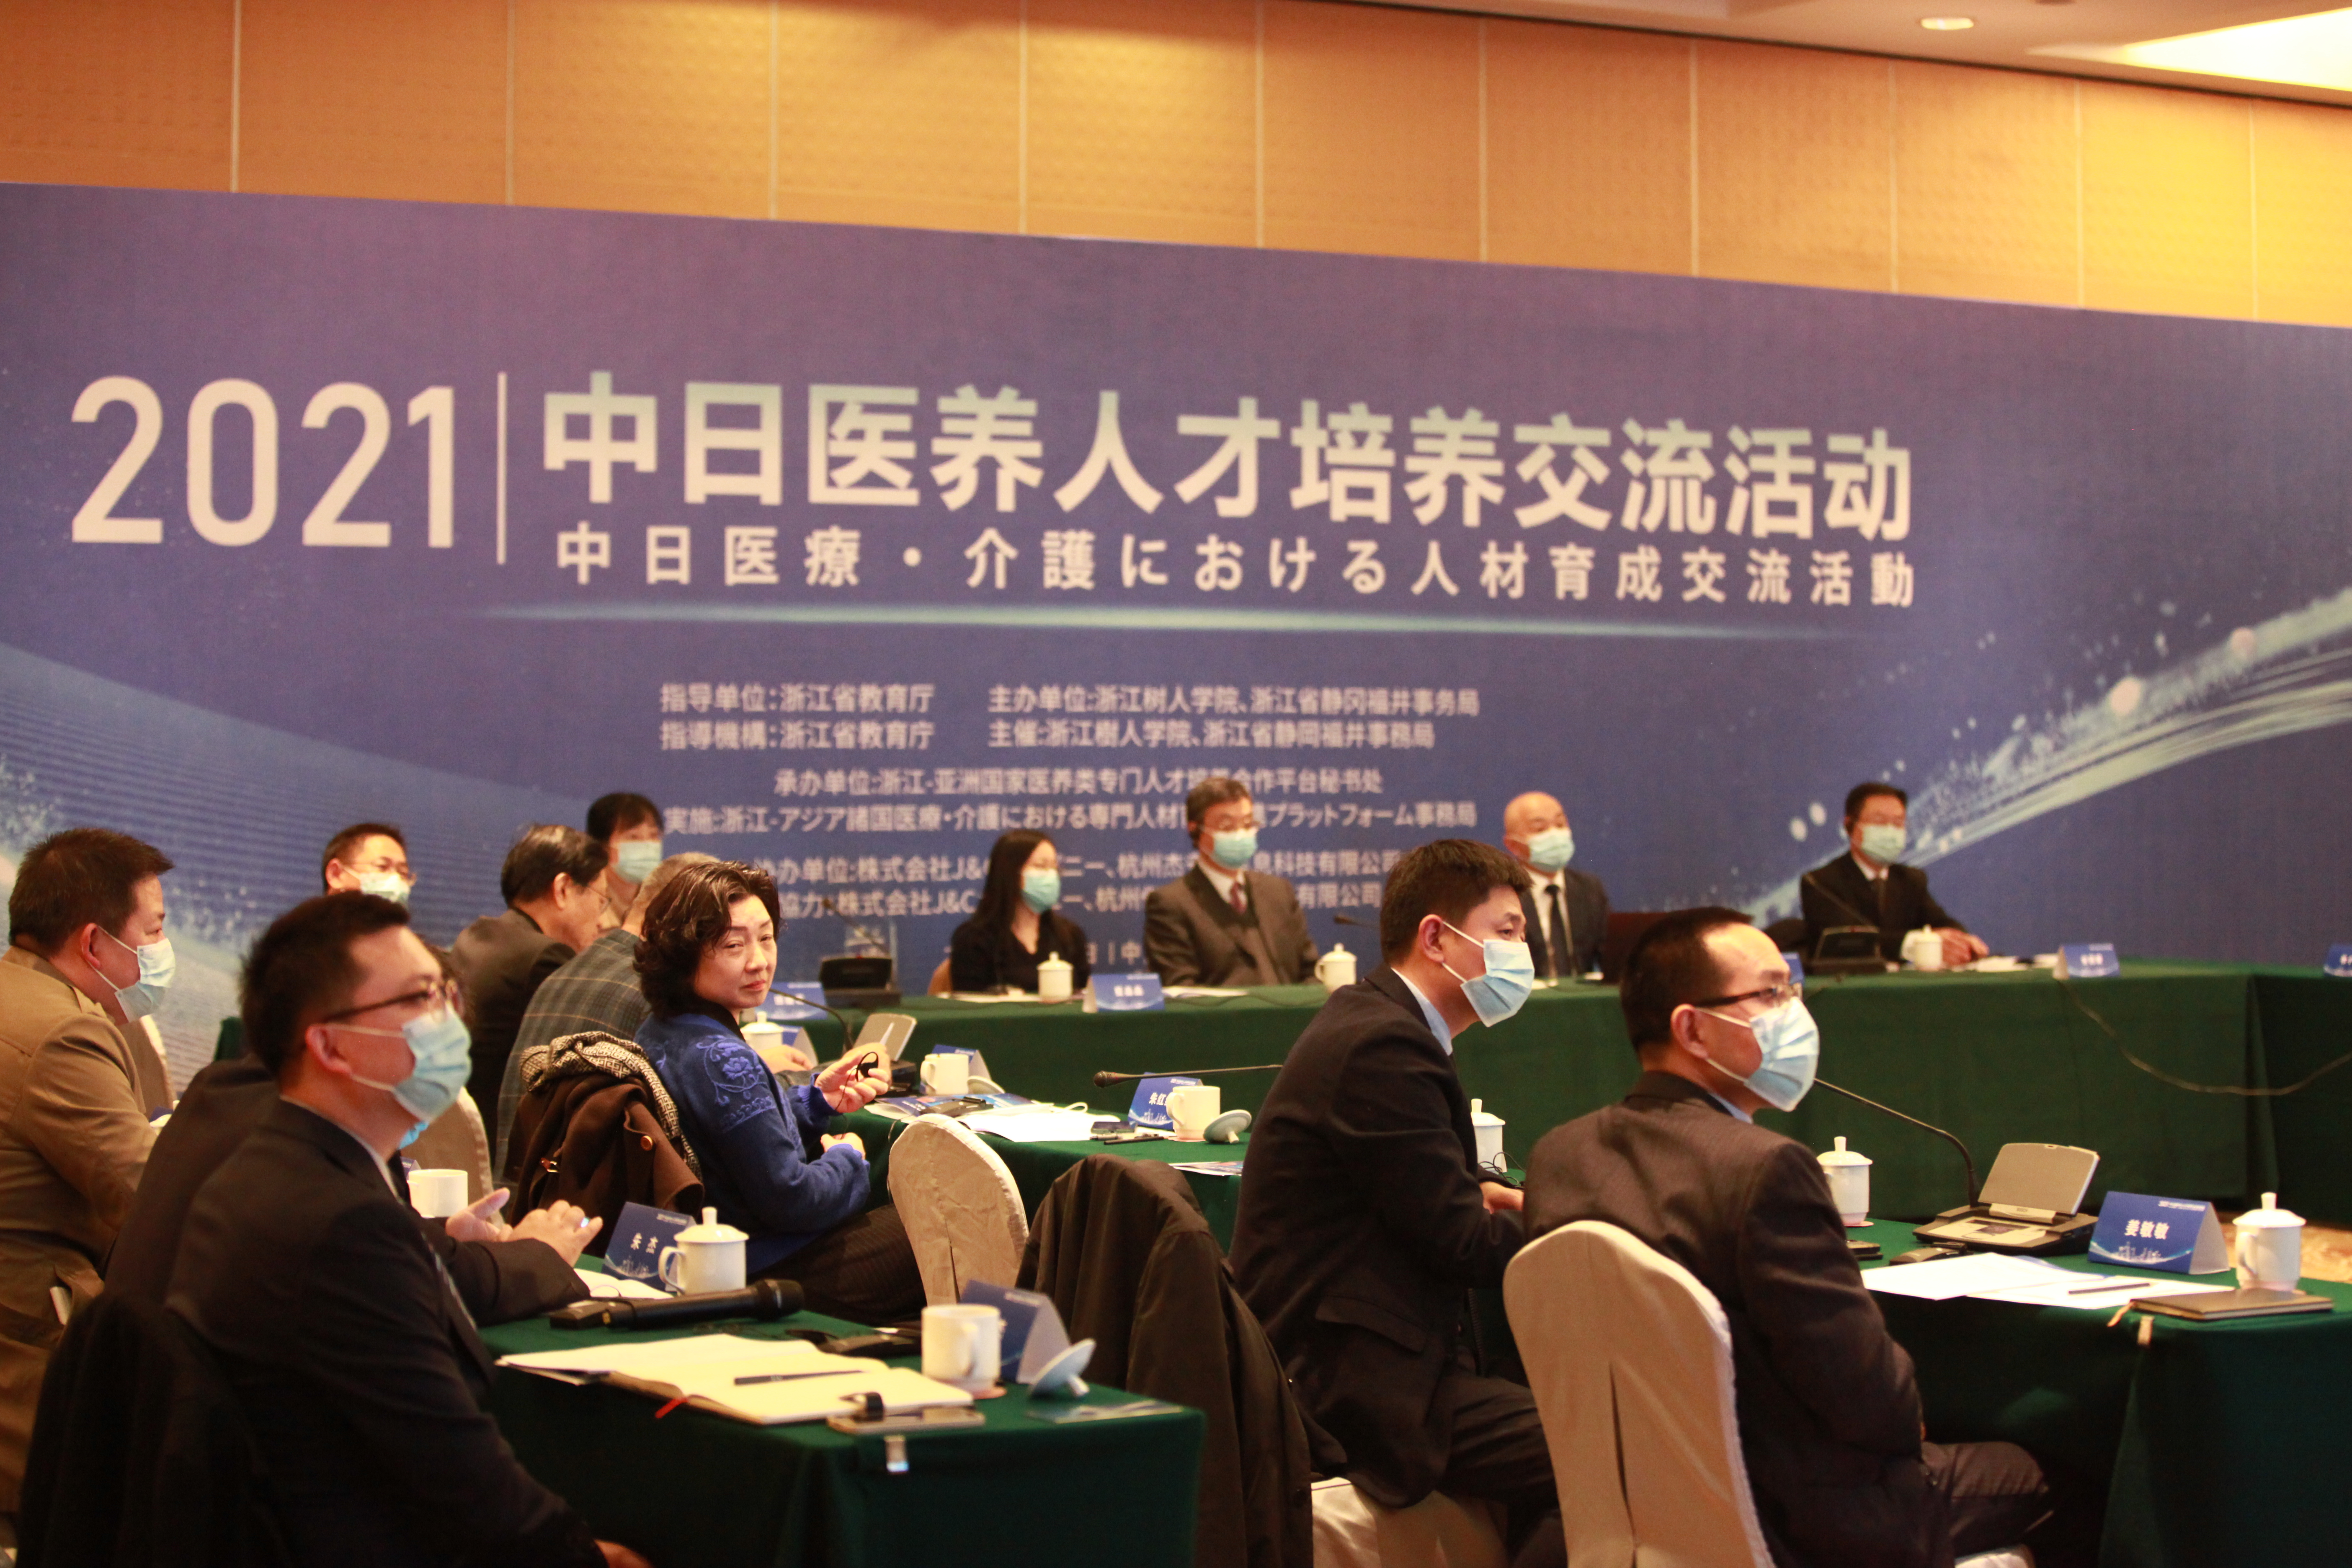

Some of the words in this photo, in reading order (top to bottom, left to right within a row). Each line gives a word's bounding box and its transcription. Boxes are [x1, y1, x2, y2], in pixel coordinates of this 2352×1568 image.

[72, 375, 454, 548] 2021
[544, 370, 1911, 541] 中日医养人才培养交流活动
[556, 520, 1915, 607] 中日医療・介護における人材育成交流活動
[660, 683, 935, 712] 指导单位:浙江省教育厅
